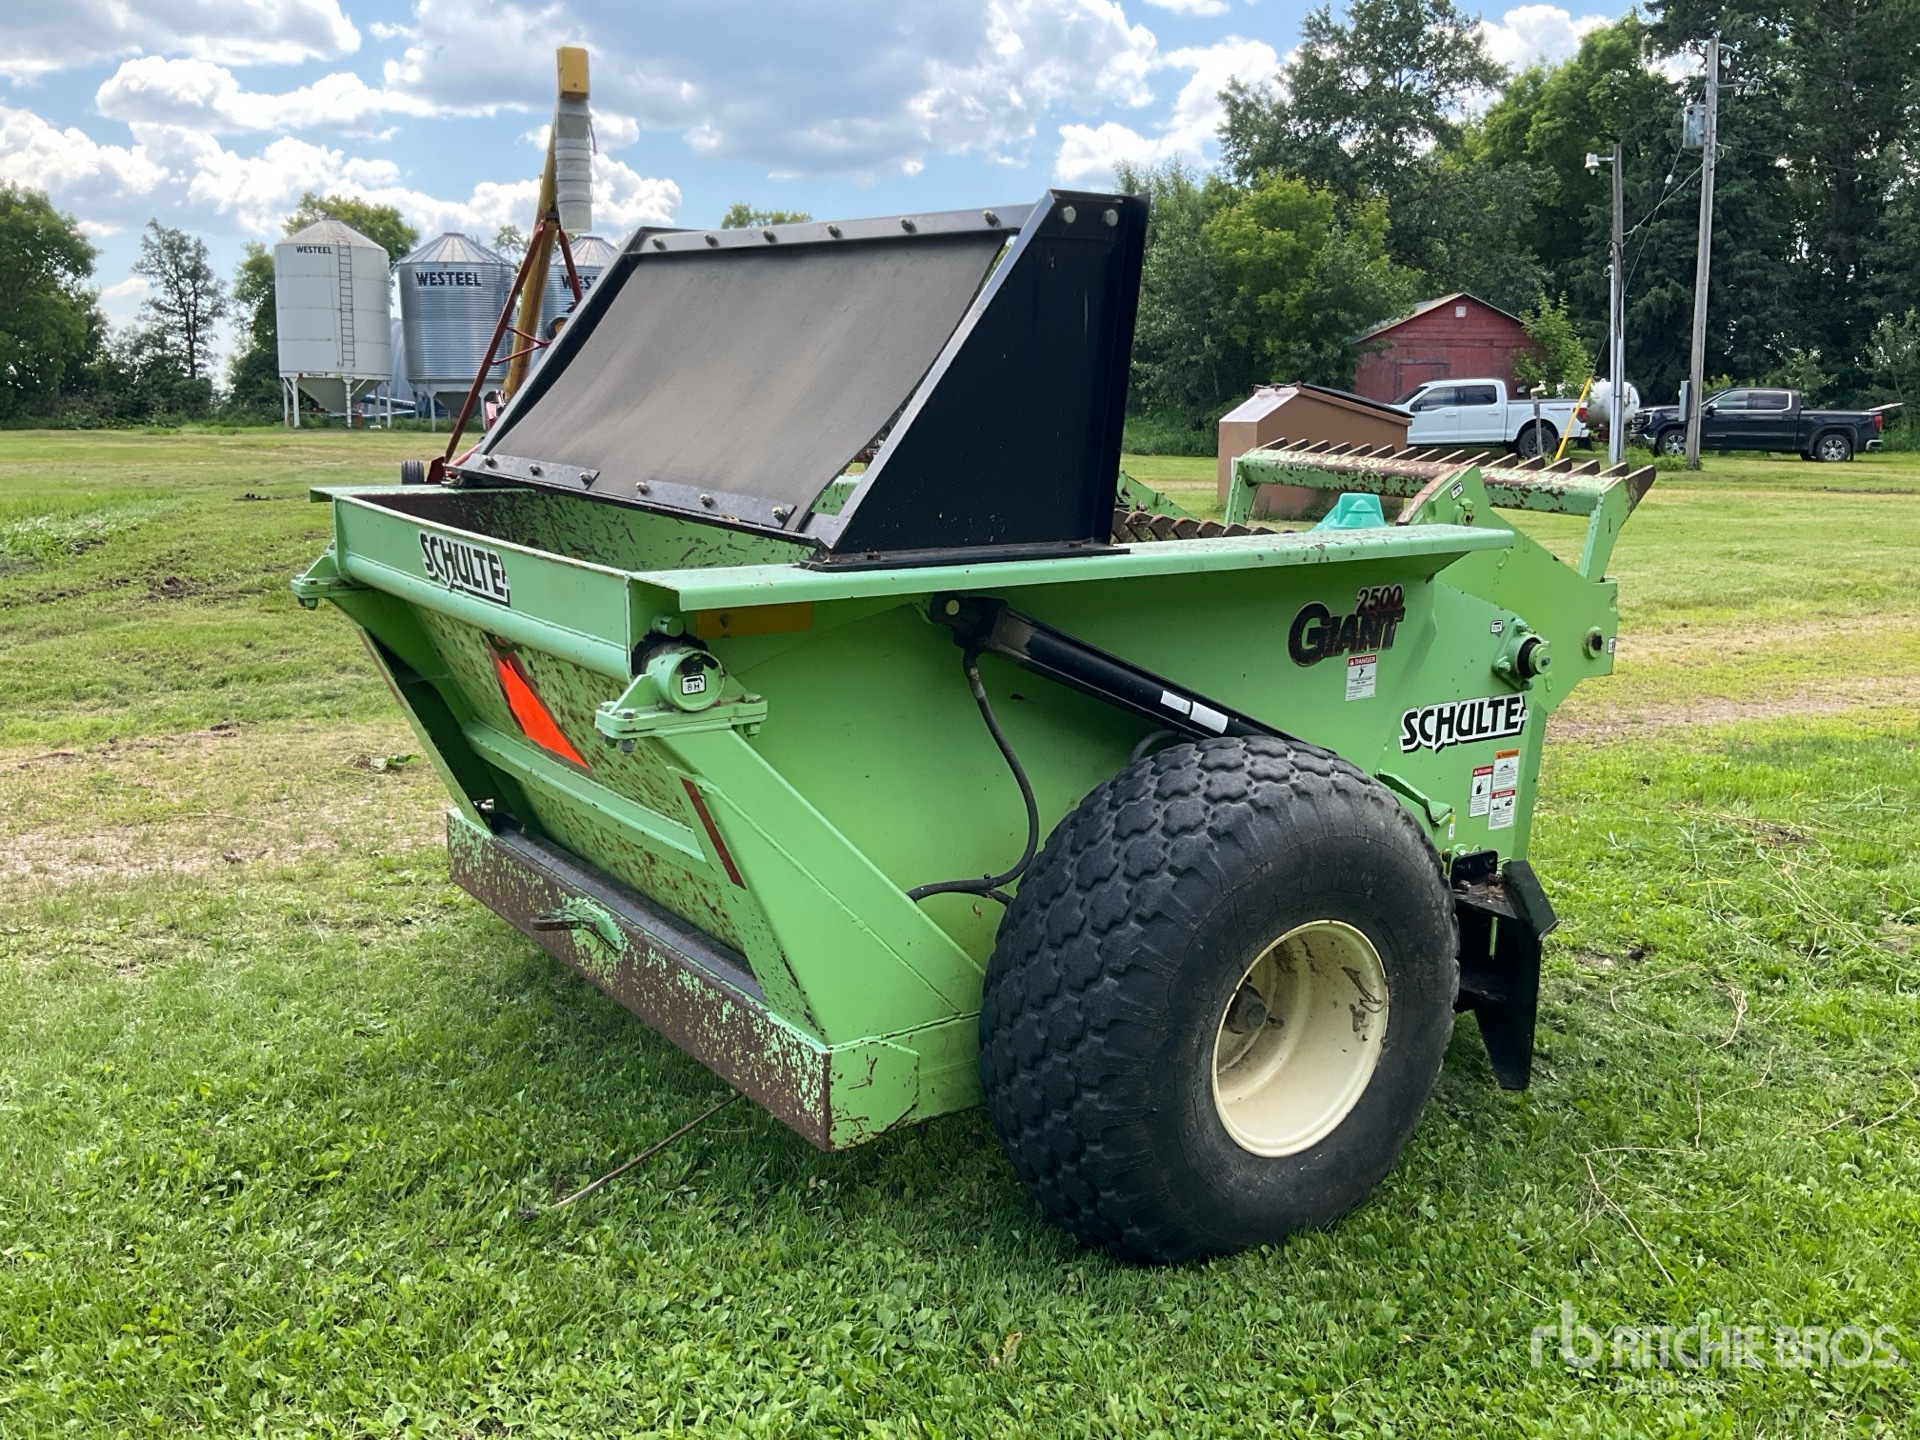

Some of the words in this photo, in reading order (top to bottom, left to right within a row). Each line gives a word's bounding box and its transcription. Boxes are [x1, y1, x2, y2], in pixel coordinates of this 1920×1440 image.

[296, 246, 332, 254] WESTEEL
[416, 272, 481, 286] WESTEEL
[419, 532, 507, 597] SCHULTE
[1358, 585, 1403, 616] 2500
[1289, 602, 1404, 667] GIANT
[1355, 656, 1375, 665] DANGER
[1401, 695, 1522, 747] SCHULTE
